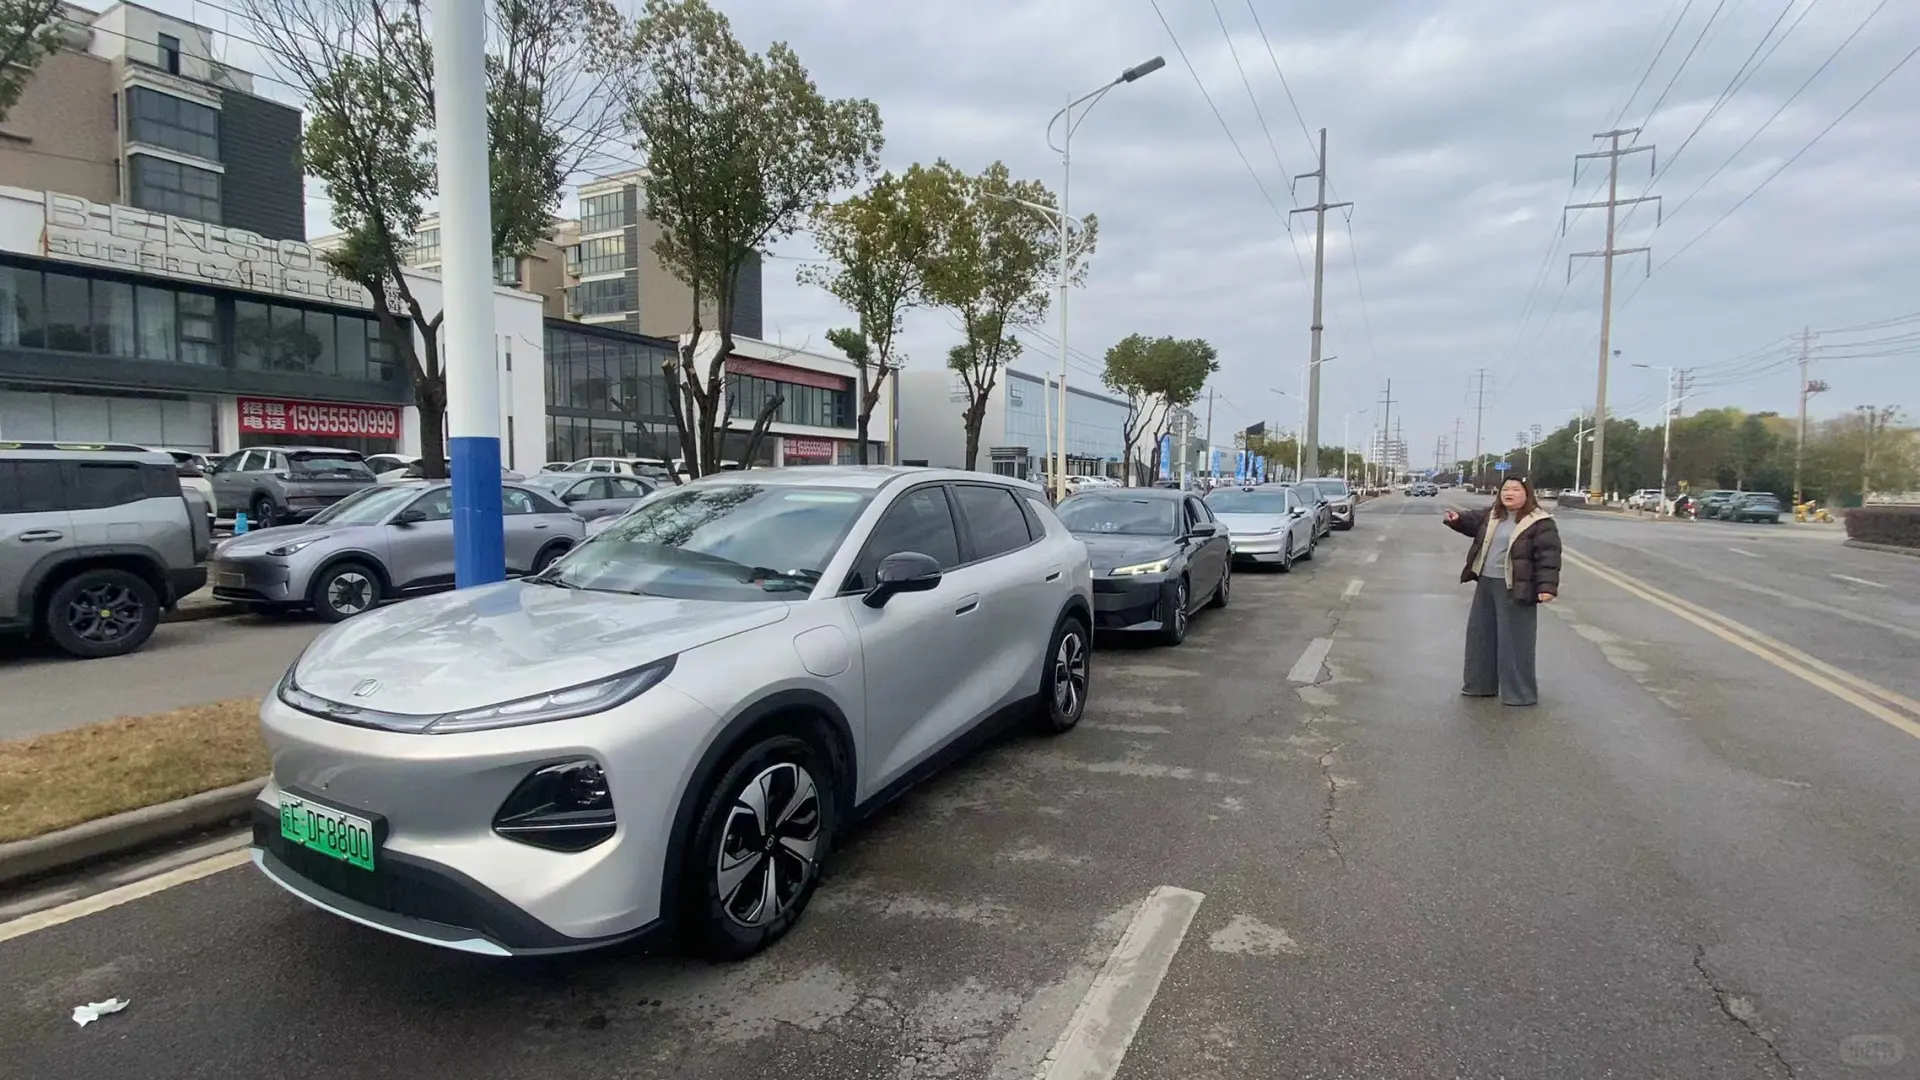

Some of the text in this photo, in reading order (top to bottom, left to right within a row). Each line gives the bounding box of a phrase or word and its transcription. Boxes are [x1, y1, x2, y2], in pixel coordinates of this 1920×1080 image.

[48, 236, 183, 273] SUPER
[197, 257, 270, 288] CAR
[242, 401, 286, 416] 招租
[289, 405, 396, 434] 15955550999
[243, 416, 286, 430] 电话
